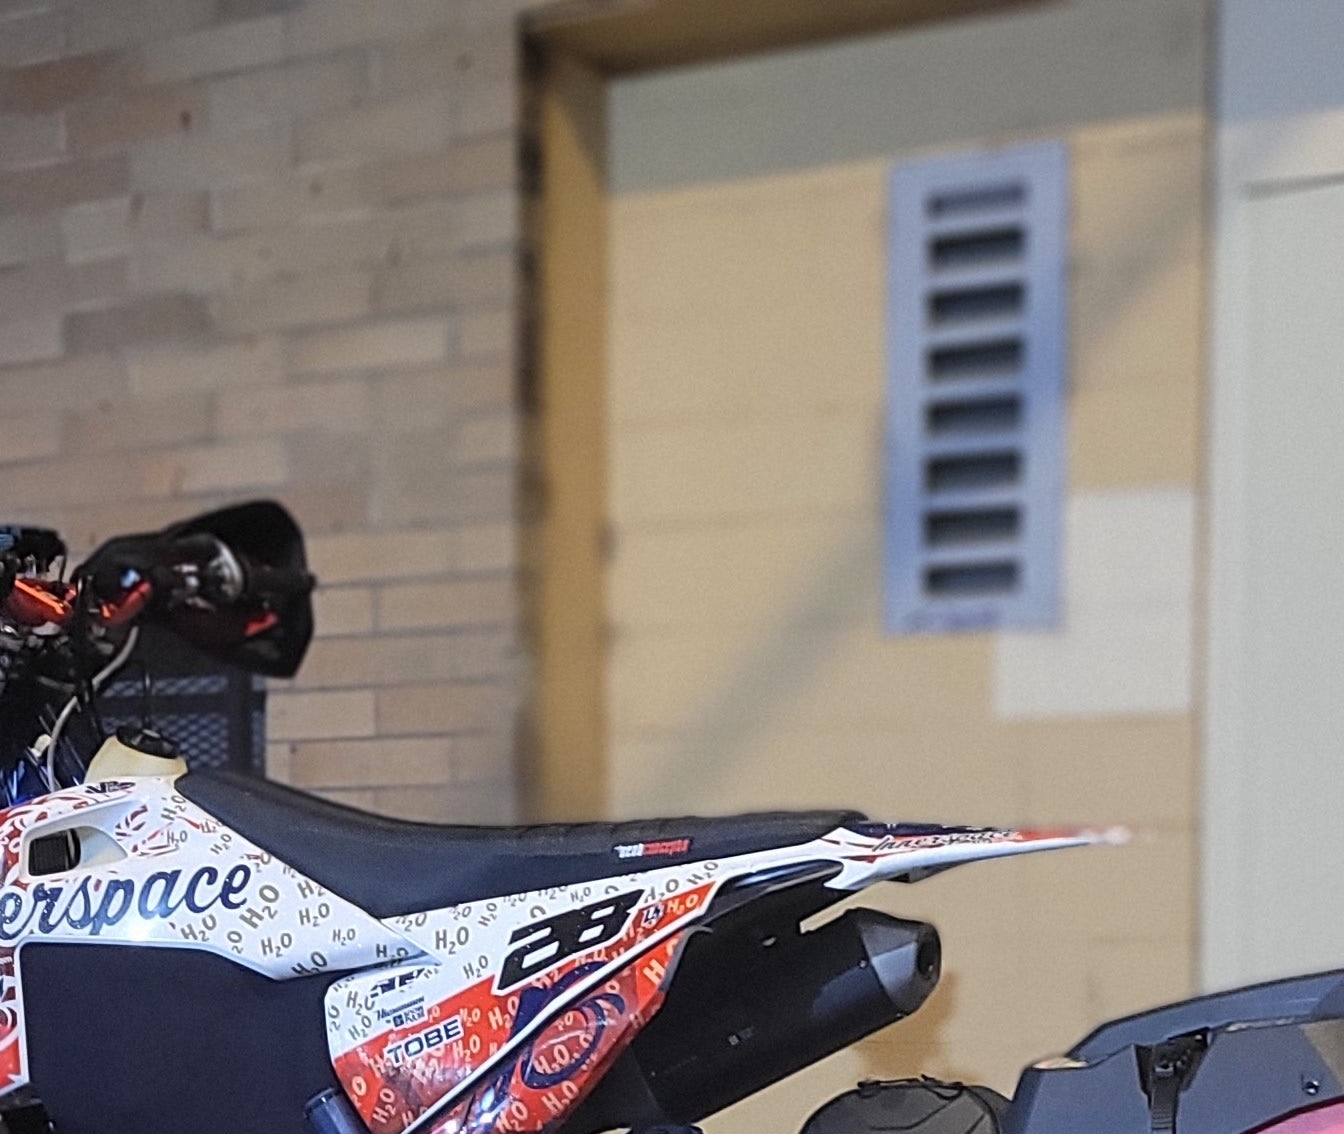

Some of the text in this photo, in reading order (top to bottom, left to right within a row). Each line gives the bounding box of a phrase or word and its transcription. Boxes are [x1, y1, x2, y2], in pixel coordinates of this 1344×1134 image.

[239, 884, 280, 930] H2O
[299, 902, 331, 927] H2O
[478, 902, 498, 927] H2O
[227, 931, 243, 954] 2O
[261, 932, 292, 958] H2O
[332, 928, 356, 946] H2O
[435, 926, 470, 954] H2O
[463, 955, 489, 980] H2O
[460, 1007, 482, 1027] H2O
[489, 996, 520, 1031] H2O
[348, 1015, 372, 1041] H2O
[386, 1019, 462, 1063] TOBE
[453, 1035, 481, 1061] H2O
[532, 1044, 571, 1076] H2O
[372, 1087, 397, 1124] H2O
[541, 1080, 580, 1115] H2O
[495, 1101, 528, 1134] H2O
